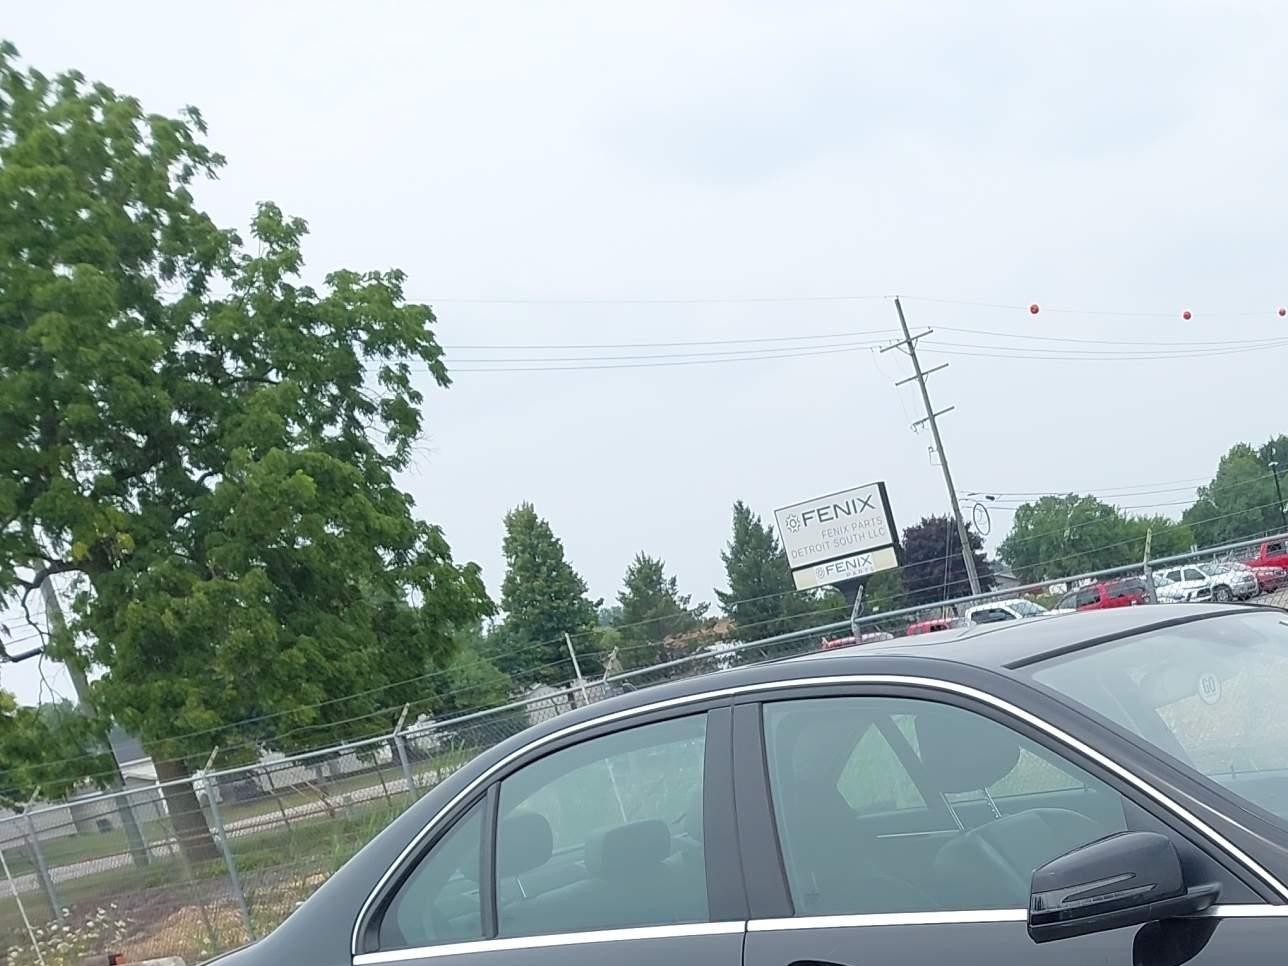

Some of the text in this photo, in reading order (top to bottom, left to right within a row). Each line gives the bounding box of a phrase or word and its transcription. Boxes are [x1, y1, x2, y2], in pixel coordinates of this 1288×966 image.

[801, 494, 876, 527] FENIX
[821, 517, 883, 539] FENIX PARTS
[791, 526, 887, 560] DETROIT SOUTH LLC
[826, 554, 873, 577] FENIX
[1202, 676, 1216, 693] GO
